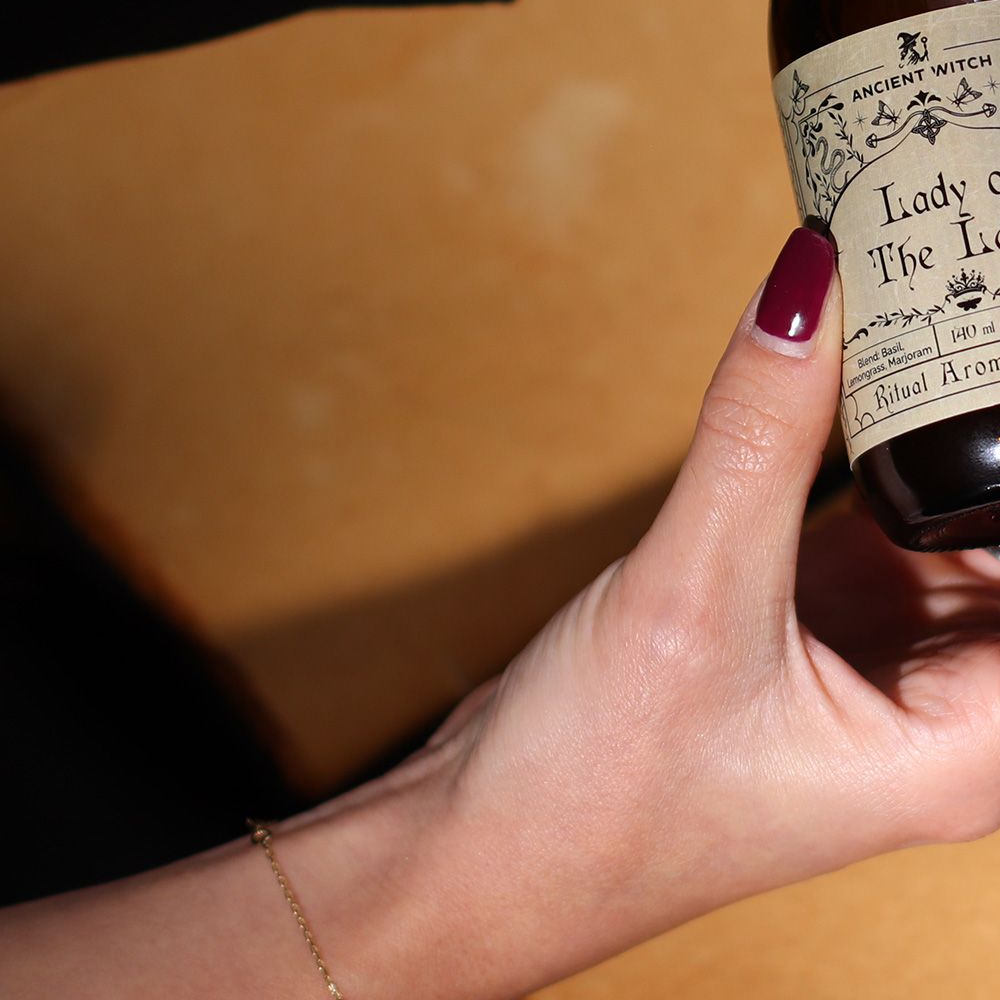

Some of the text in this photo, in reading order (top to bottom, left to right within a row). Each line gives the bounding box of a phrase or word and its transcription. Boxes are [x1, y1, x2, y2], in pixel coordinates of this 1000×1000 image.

[852, 53, 993, 102] ANCIENT WITCH
[873, 171, 971, 227] Lady
[867, 236, 935, 291] The
[951, 321, 996, 343] 140 ml
[846, 346, 933, 388] Lemongrass, Marjoram
[857, 351, 880, 369] Blend:
[873, 371, 928, 413] Ritual
